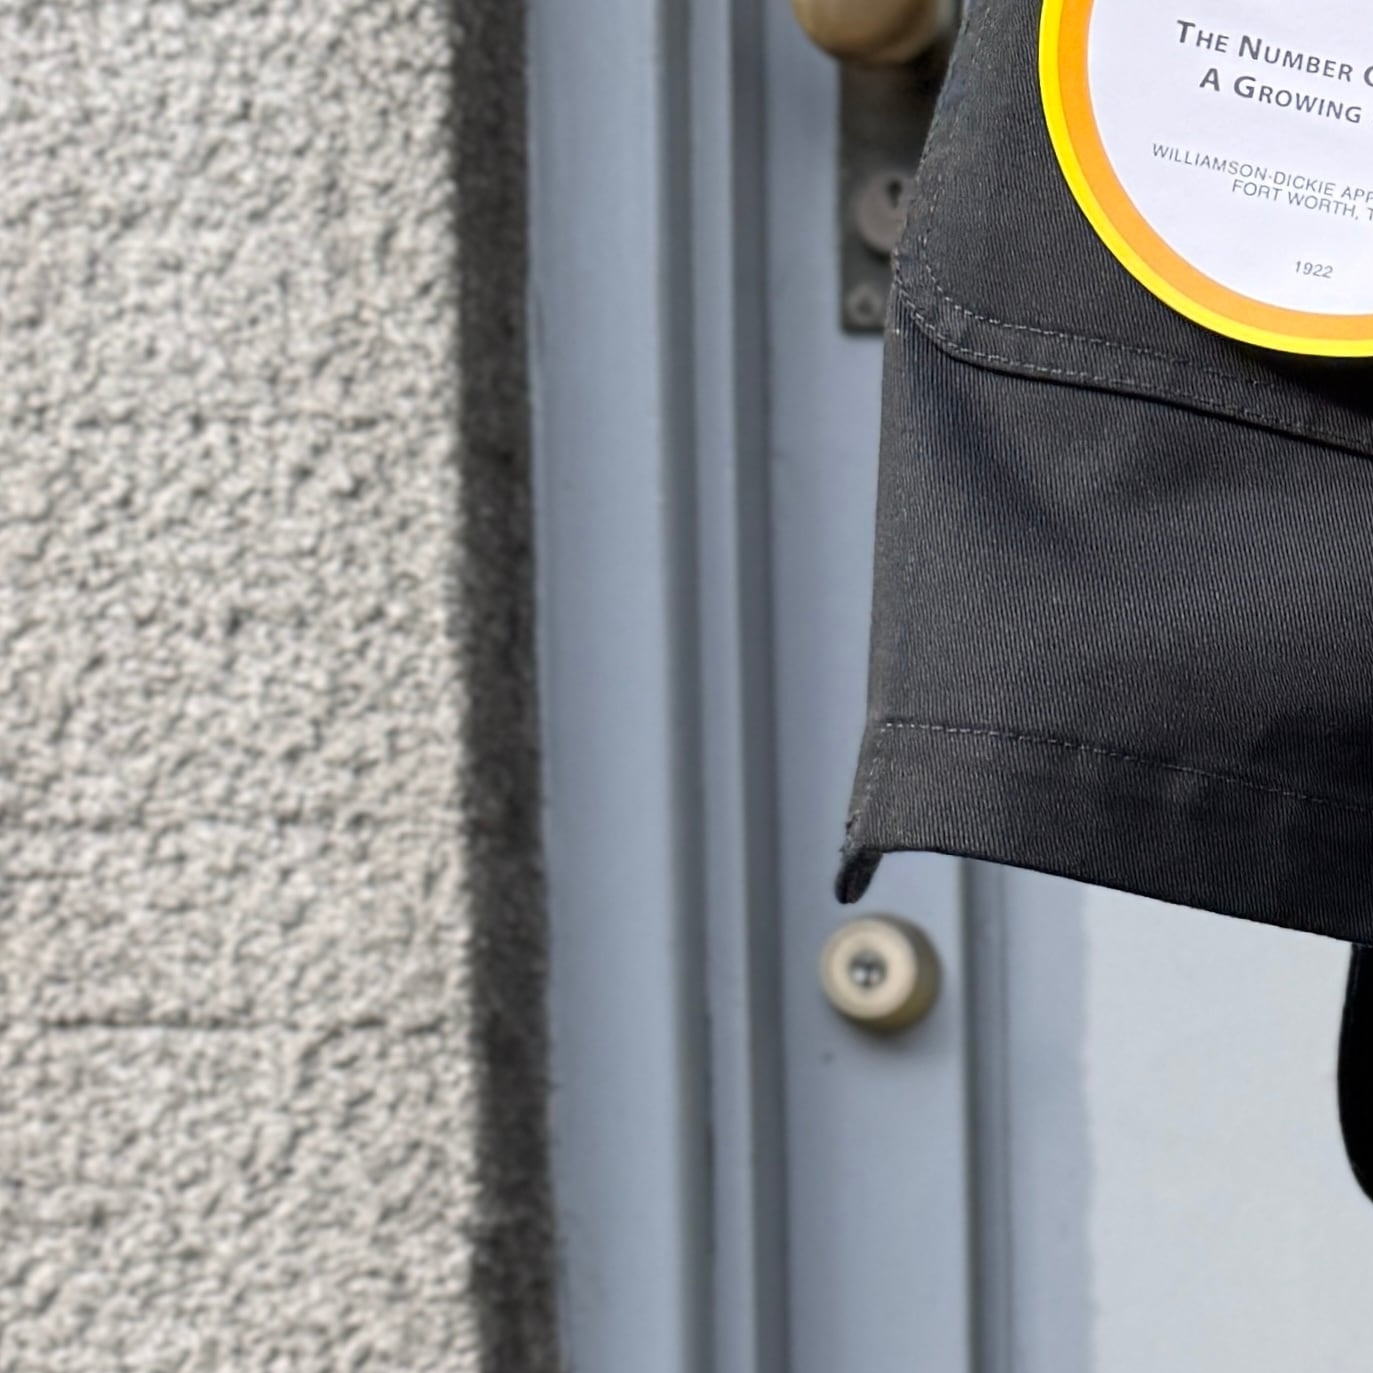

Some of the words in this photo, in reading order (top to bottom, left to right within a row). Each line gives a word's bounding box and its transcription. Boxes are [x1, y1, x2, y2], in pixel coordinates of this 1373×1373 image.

[1177, 19, 1230, 53] THE
[1238, 35, 1353, 83] NUMBER
[1199, 67, 1221, 92] A
[1233, 75, 1362, 124] GROWING
[1232, 178, 1283, 202] FORT
[1287, 191, 1359, 221] WORTH,
[1295, 260, 1334, 279] 1922
